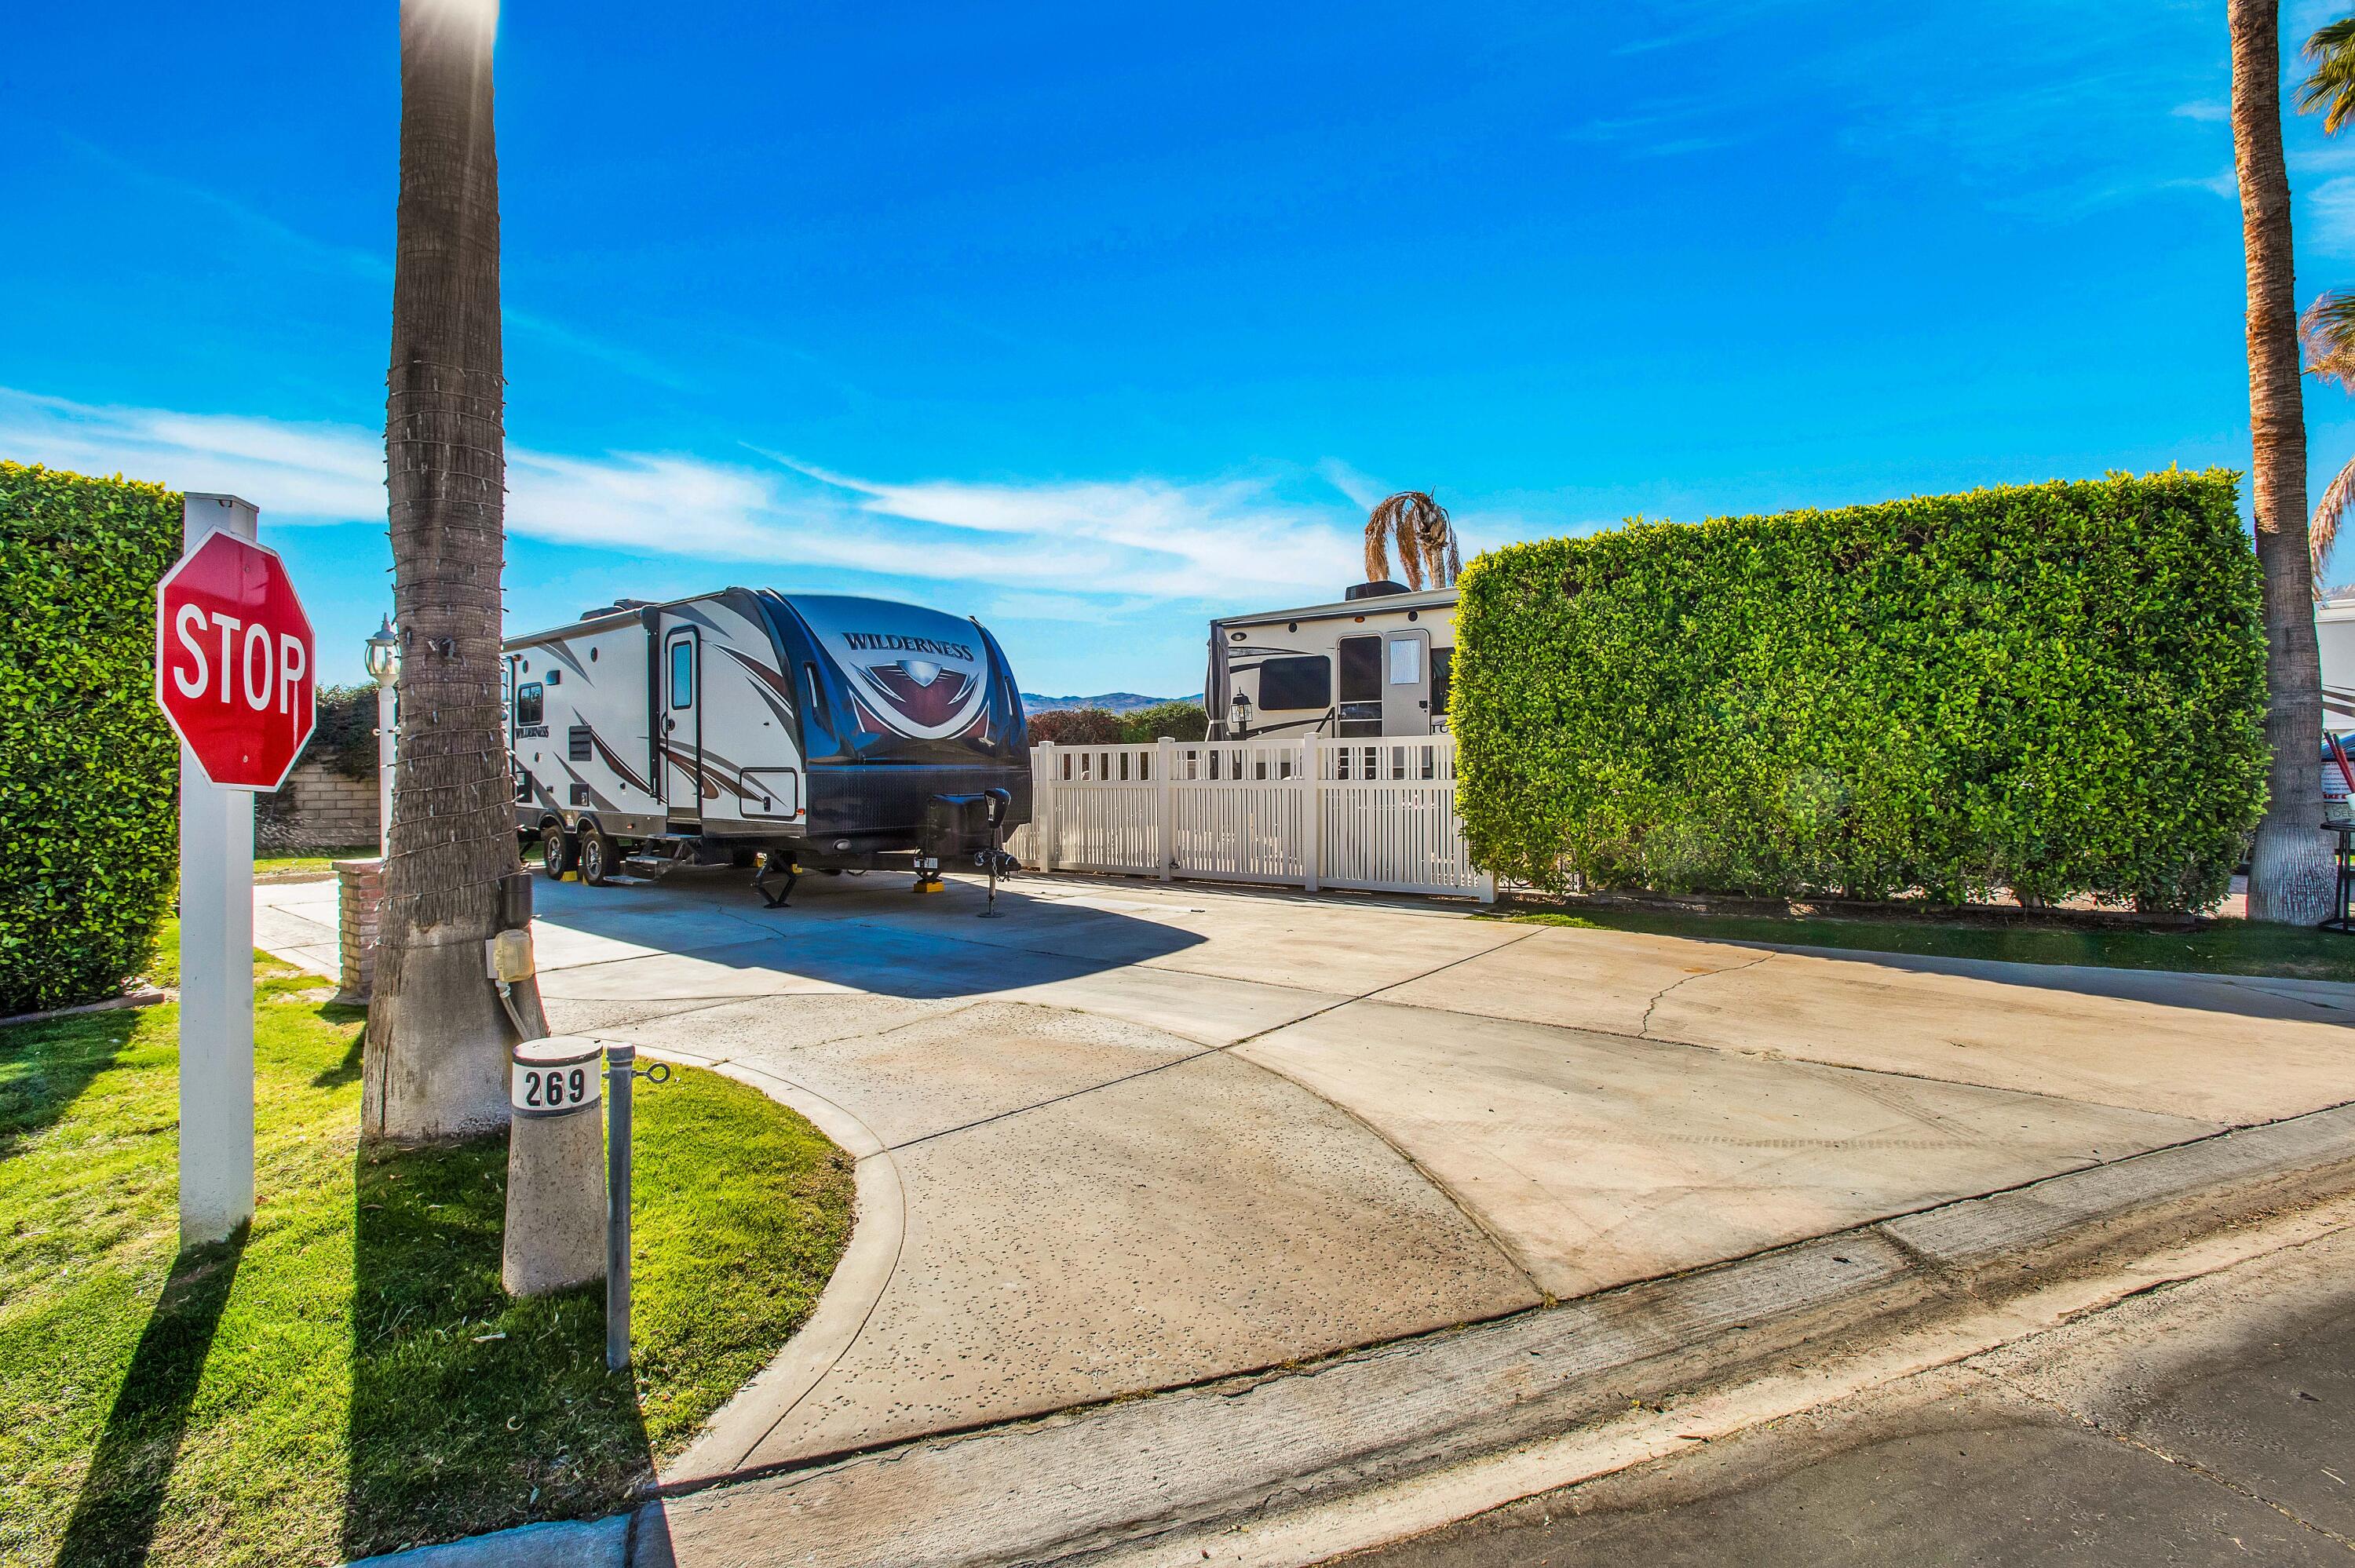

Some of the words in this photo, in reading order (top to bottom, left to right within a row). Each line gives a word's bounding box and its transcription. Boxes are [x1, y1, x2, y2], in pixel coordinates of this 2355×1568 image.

[173, 603, 306, 714] STOP
[842, 632, 974, 662] WILDERNESS
[515, 725, 550, 739] WILDERNESS
[525, 1068, 584, 1107] 269
